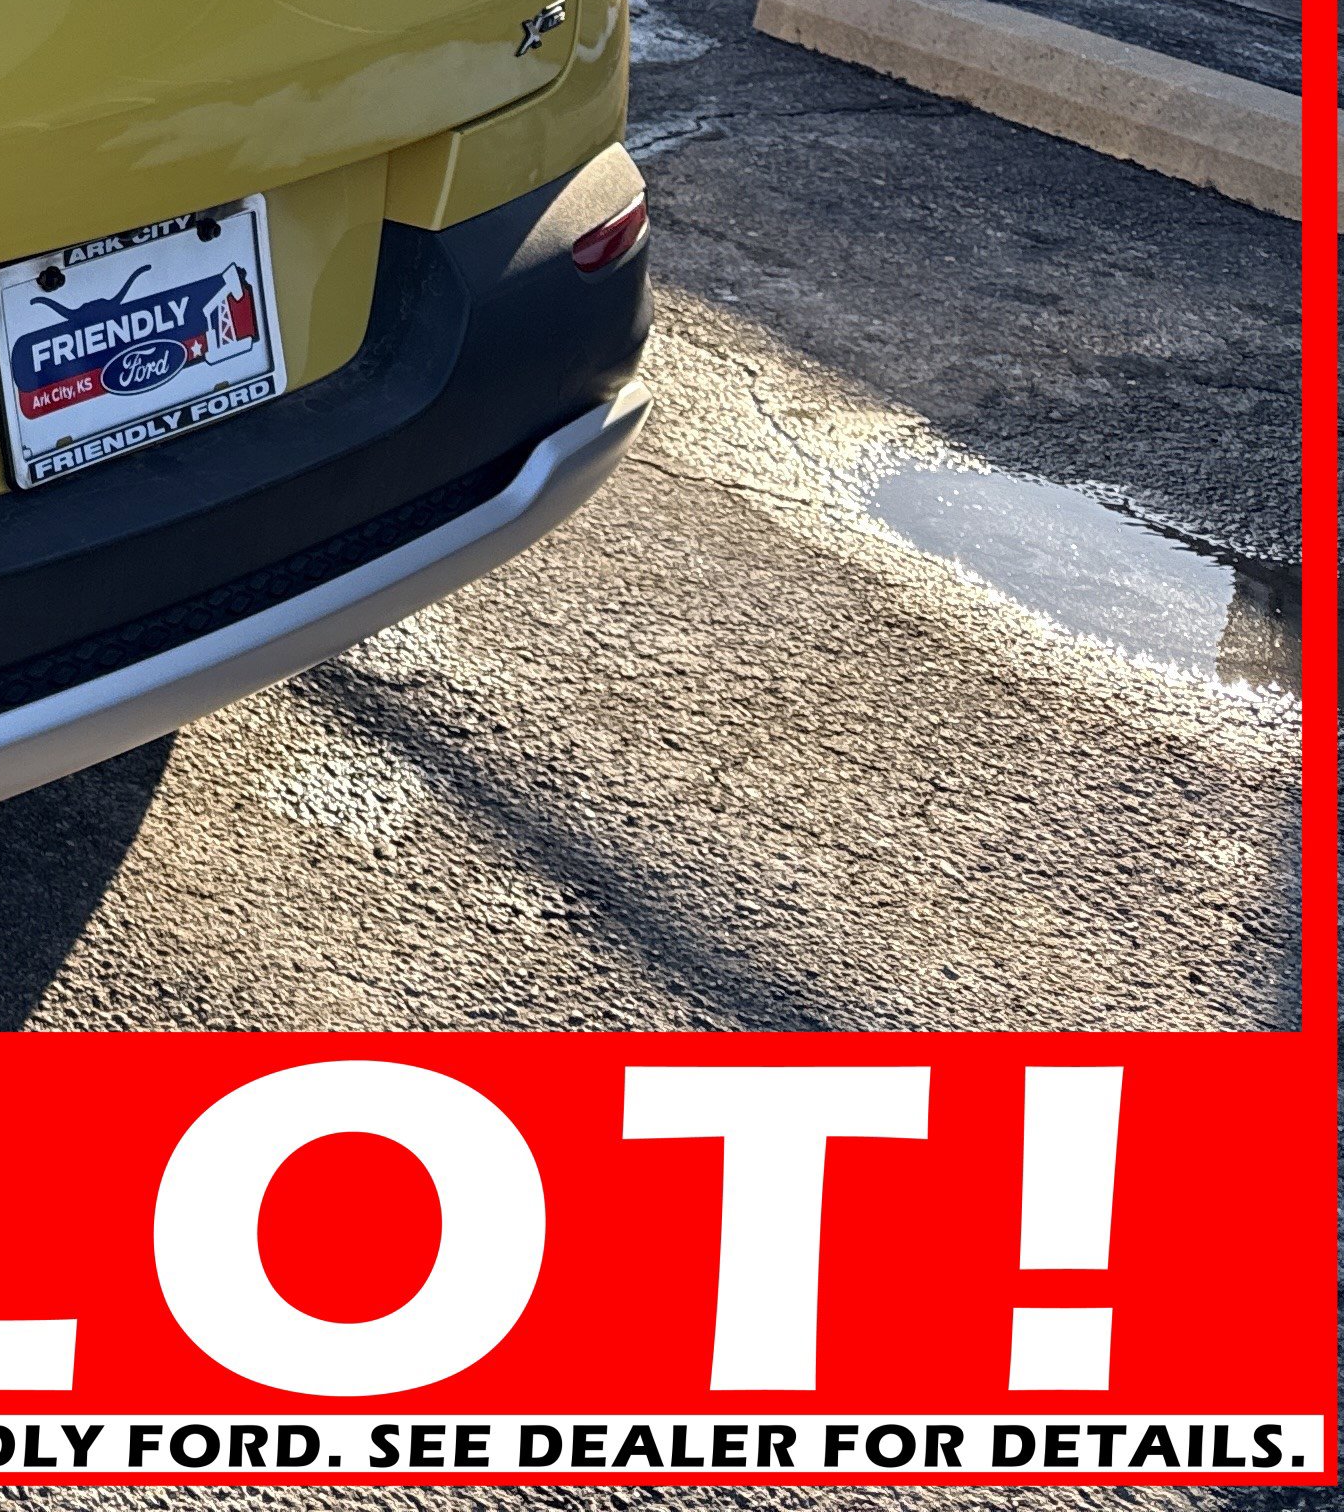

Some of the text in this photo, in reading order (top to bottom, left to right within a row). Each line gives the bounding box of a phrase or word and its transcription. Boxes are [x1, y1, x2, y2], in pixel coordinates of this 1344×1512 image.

[69, 214, 192, 265] ARK CITY
[31, 296, 190, 373] FRIENDLY
[118, 347, 170, 387] Ford
[32, 377, 93, 410] Ark City, KS
[34, 380, 271, 479] FRIENDLY FORD
